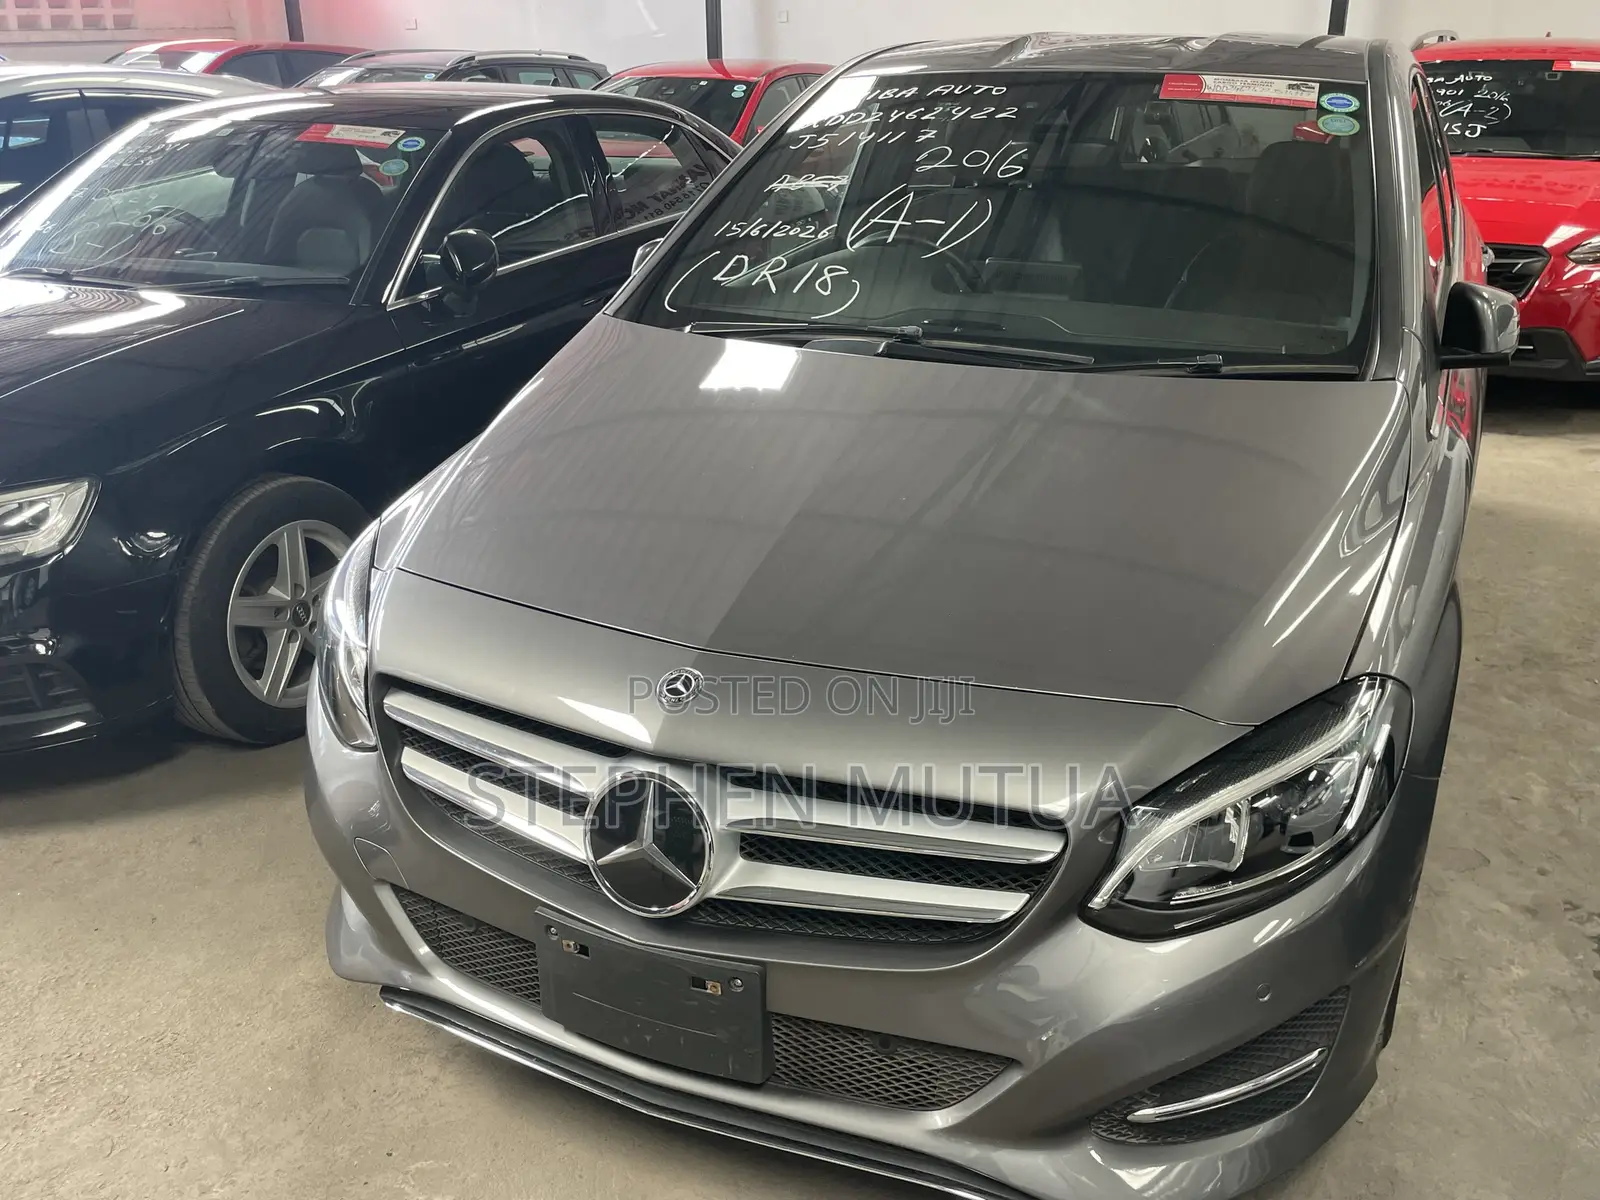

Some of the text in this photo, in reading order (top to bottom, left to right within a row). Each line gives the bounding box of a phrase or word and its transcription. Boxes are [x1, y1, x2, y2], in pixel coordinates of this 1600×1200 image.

[1445, 74, 1493, 84] AUTO
[926, 84, 1007, 96] AUTO
[915, 141, 1028, 178] 2016
[714, 217, 838, 239] 15/6/2026
